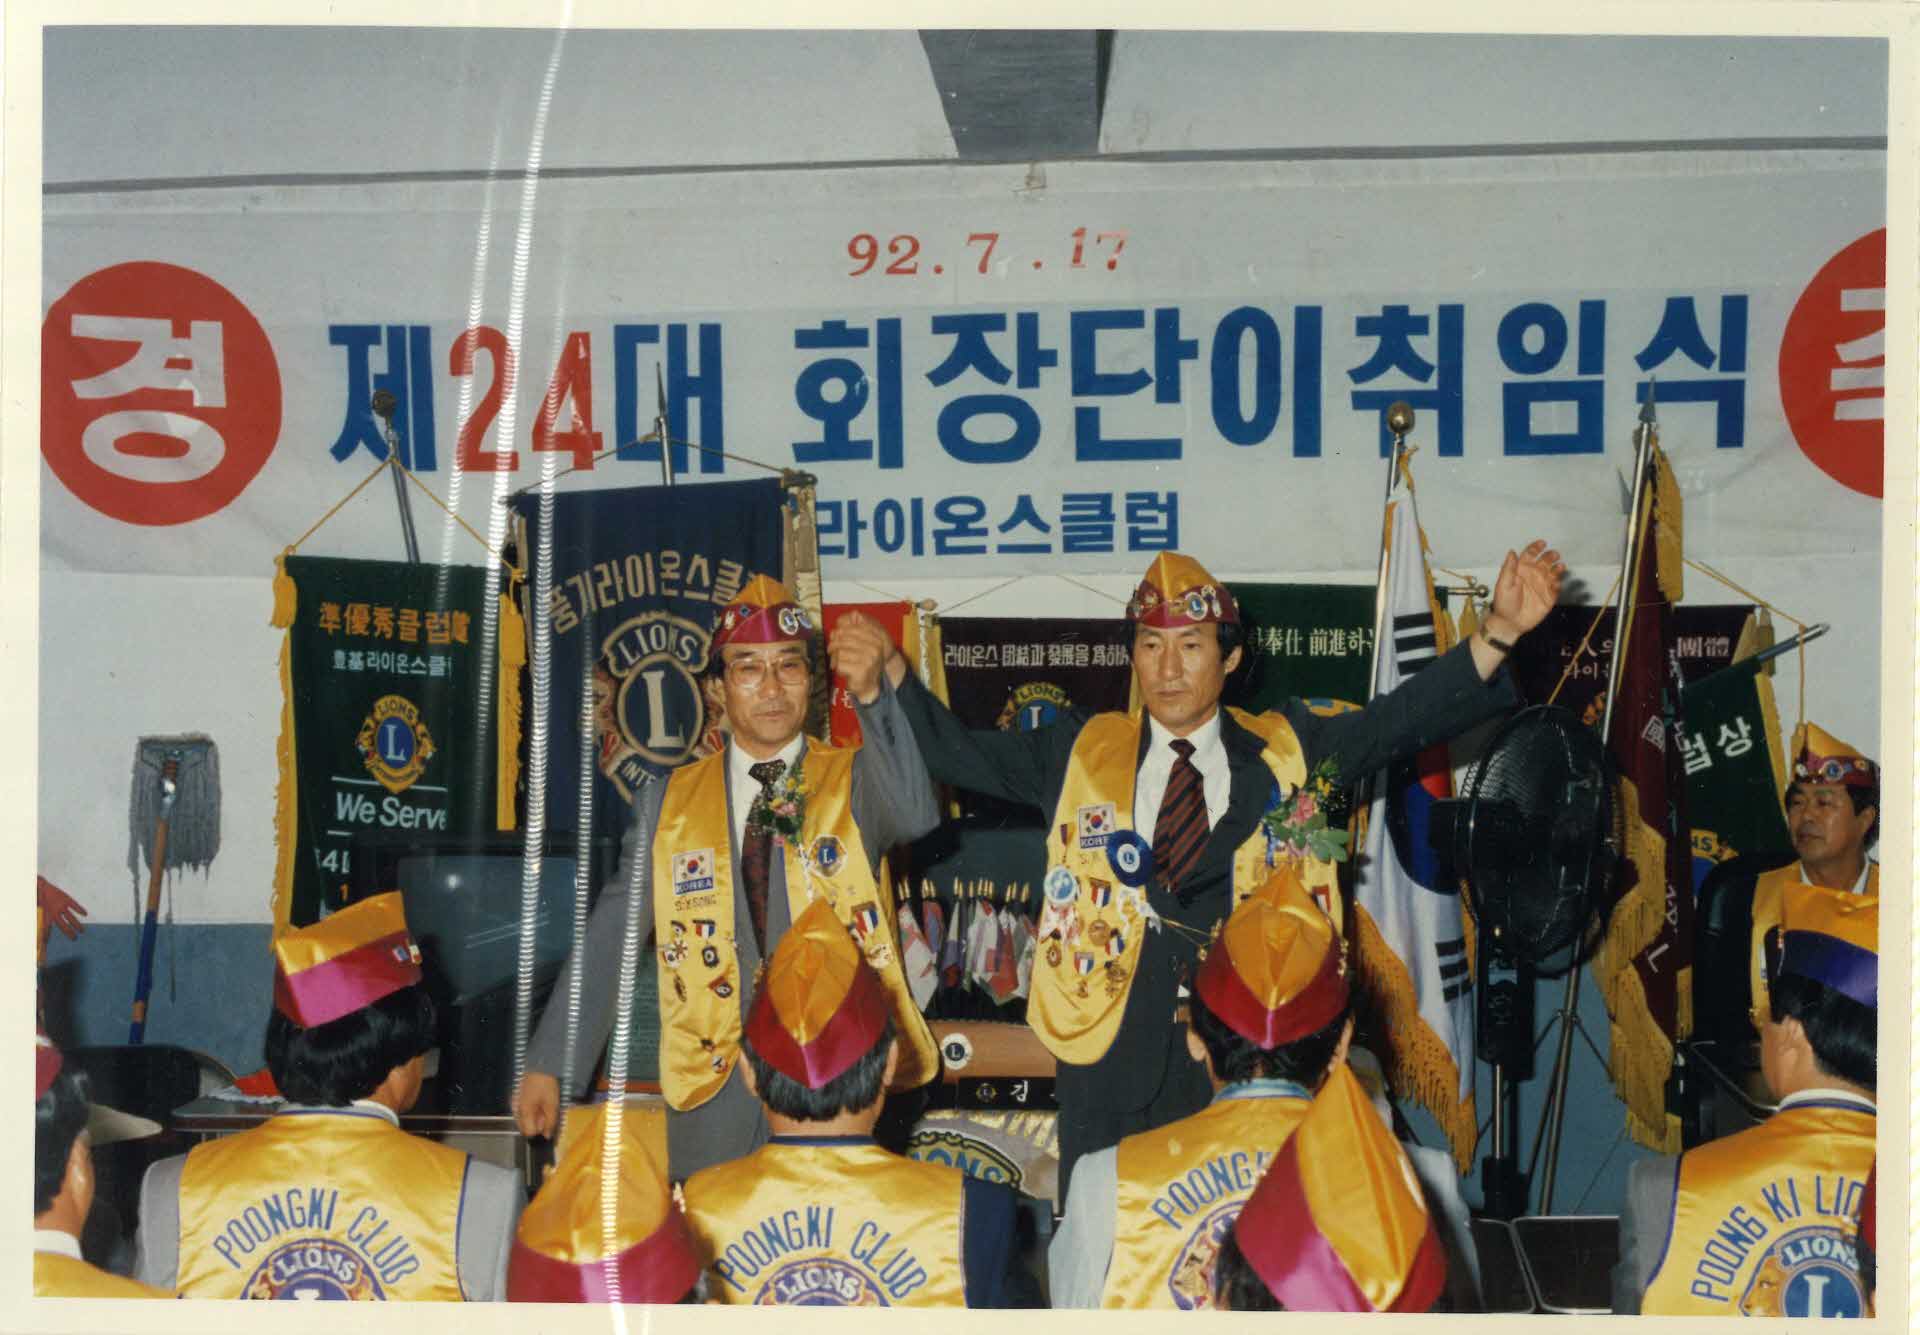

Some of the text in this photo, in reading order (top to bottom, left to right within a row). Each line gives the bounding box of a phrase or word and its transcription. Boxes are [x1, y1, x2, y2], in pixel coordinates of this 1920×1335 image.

[71, 314, 227, 483] 경
[329, 324, 724, 473] 제24대
[385, 725, 406, 761] L
[642, 671, 686, 748] L
[336, 792, 376, 823] We
[213, 1187, 338, 1269] POONGKI
[276, 1248, 358, 1282] LIONS
[714, 1206, 835, 1294] POONGKI
[1691, 1205, 1768, 1302] POONG
[777, 1267, 861, 1301] LIONS
